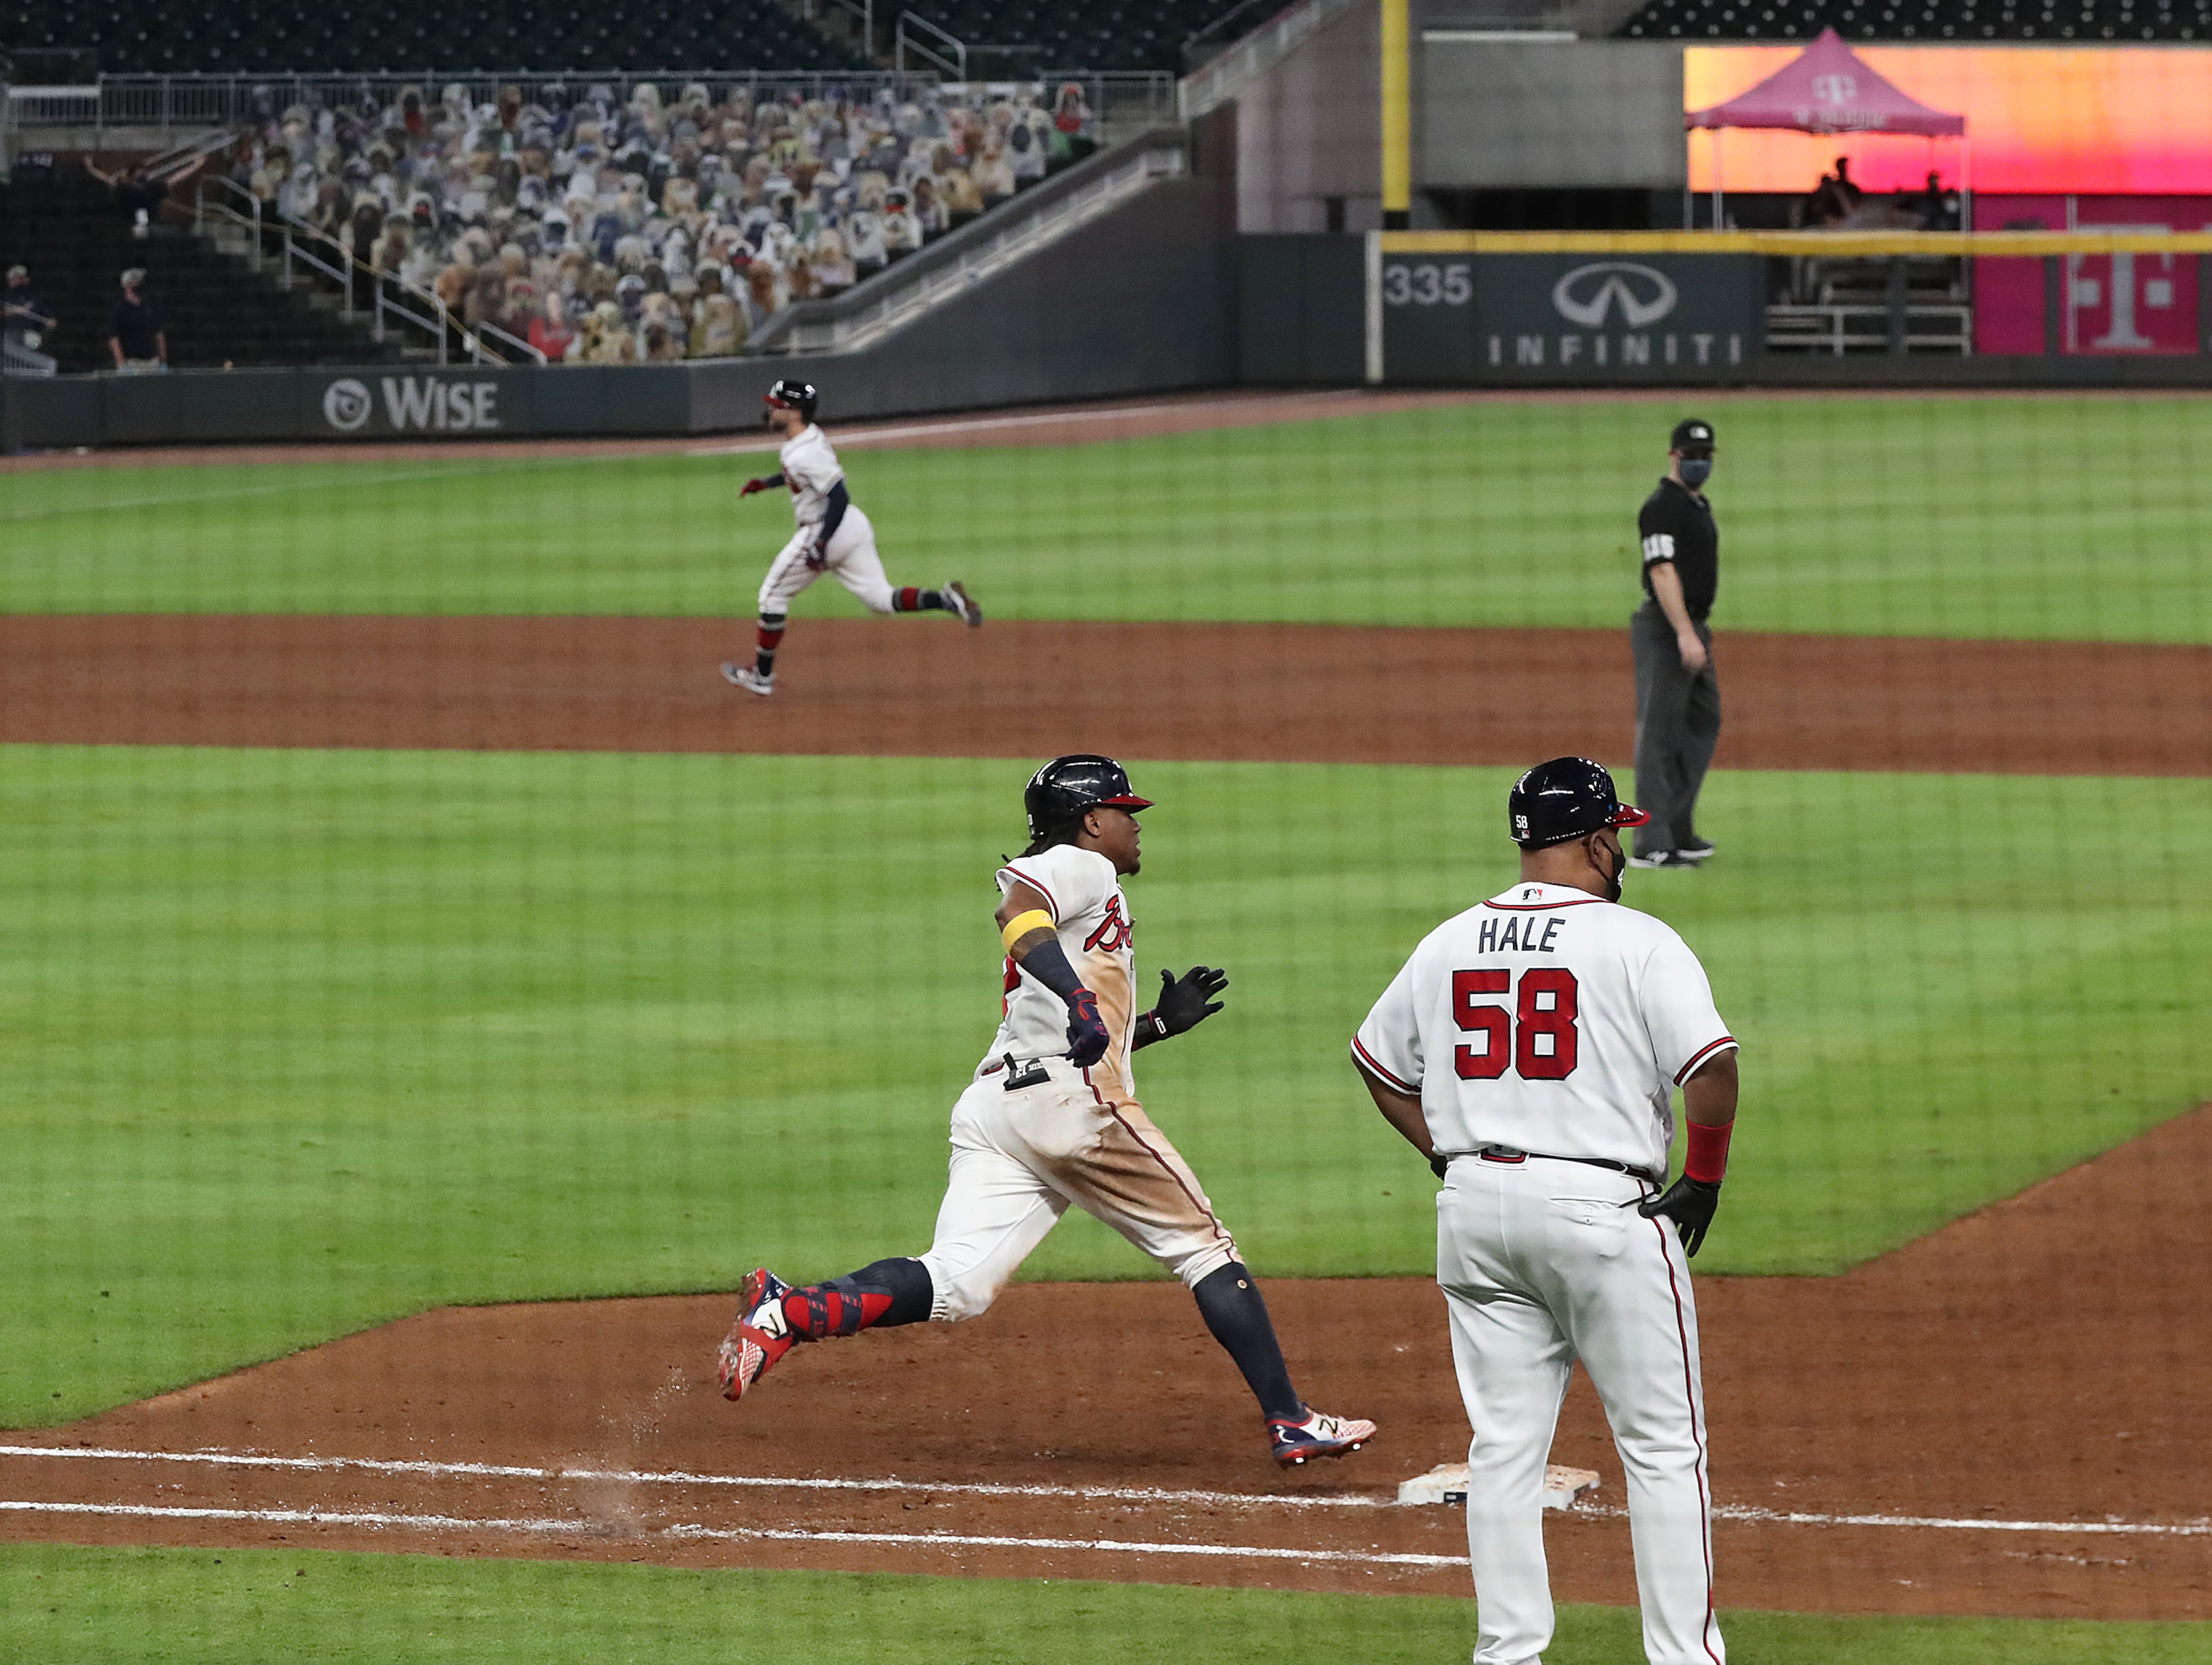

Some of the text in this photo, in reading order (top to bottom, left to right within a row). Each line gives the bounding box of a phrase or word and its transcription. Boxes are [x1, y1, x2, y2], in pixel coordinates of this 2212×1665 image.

[1384, 263, 1473, 306] 335
[1488, 333, 1741, 366] INFINITI
[381, 376, 500, 430] WISE
[1516, 815, 1528, 828] 58
[1478, 917, 1566, 953] HALE
[1452, 968, 1578, 1080] 58
